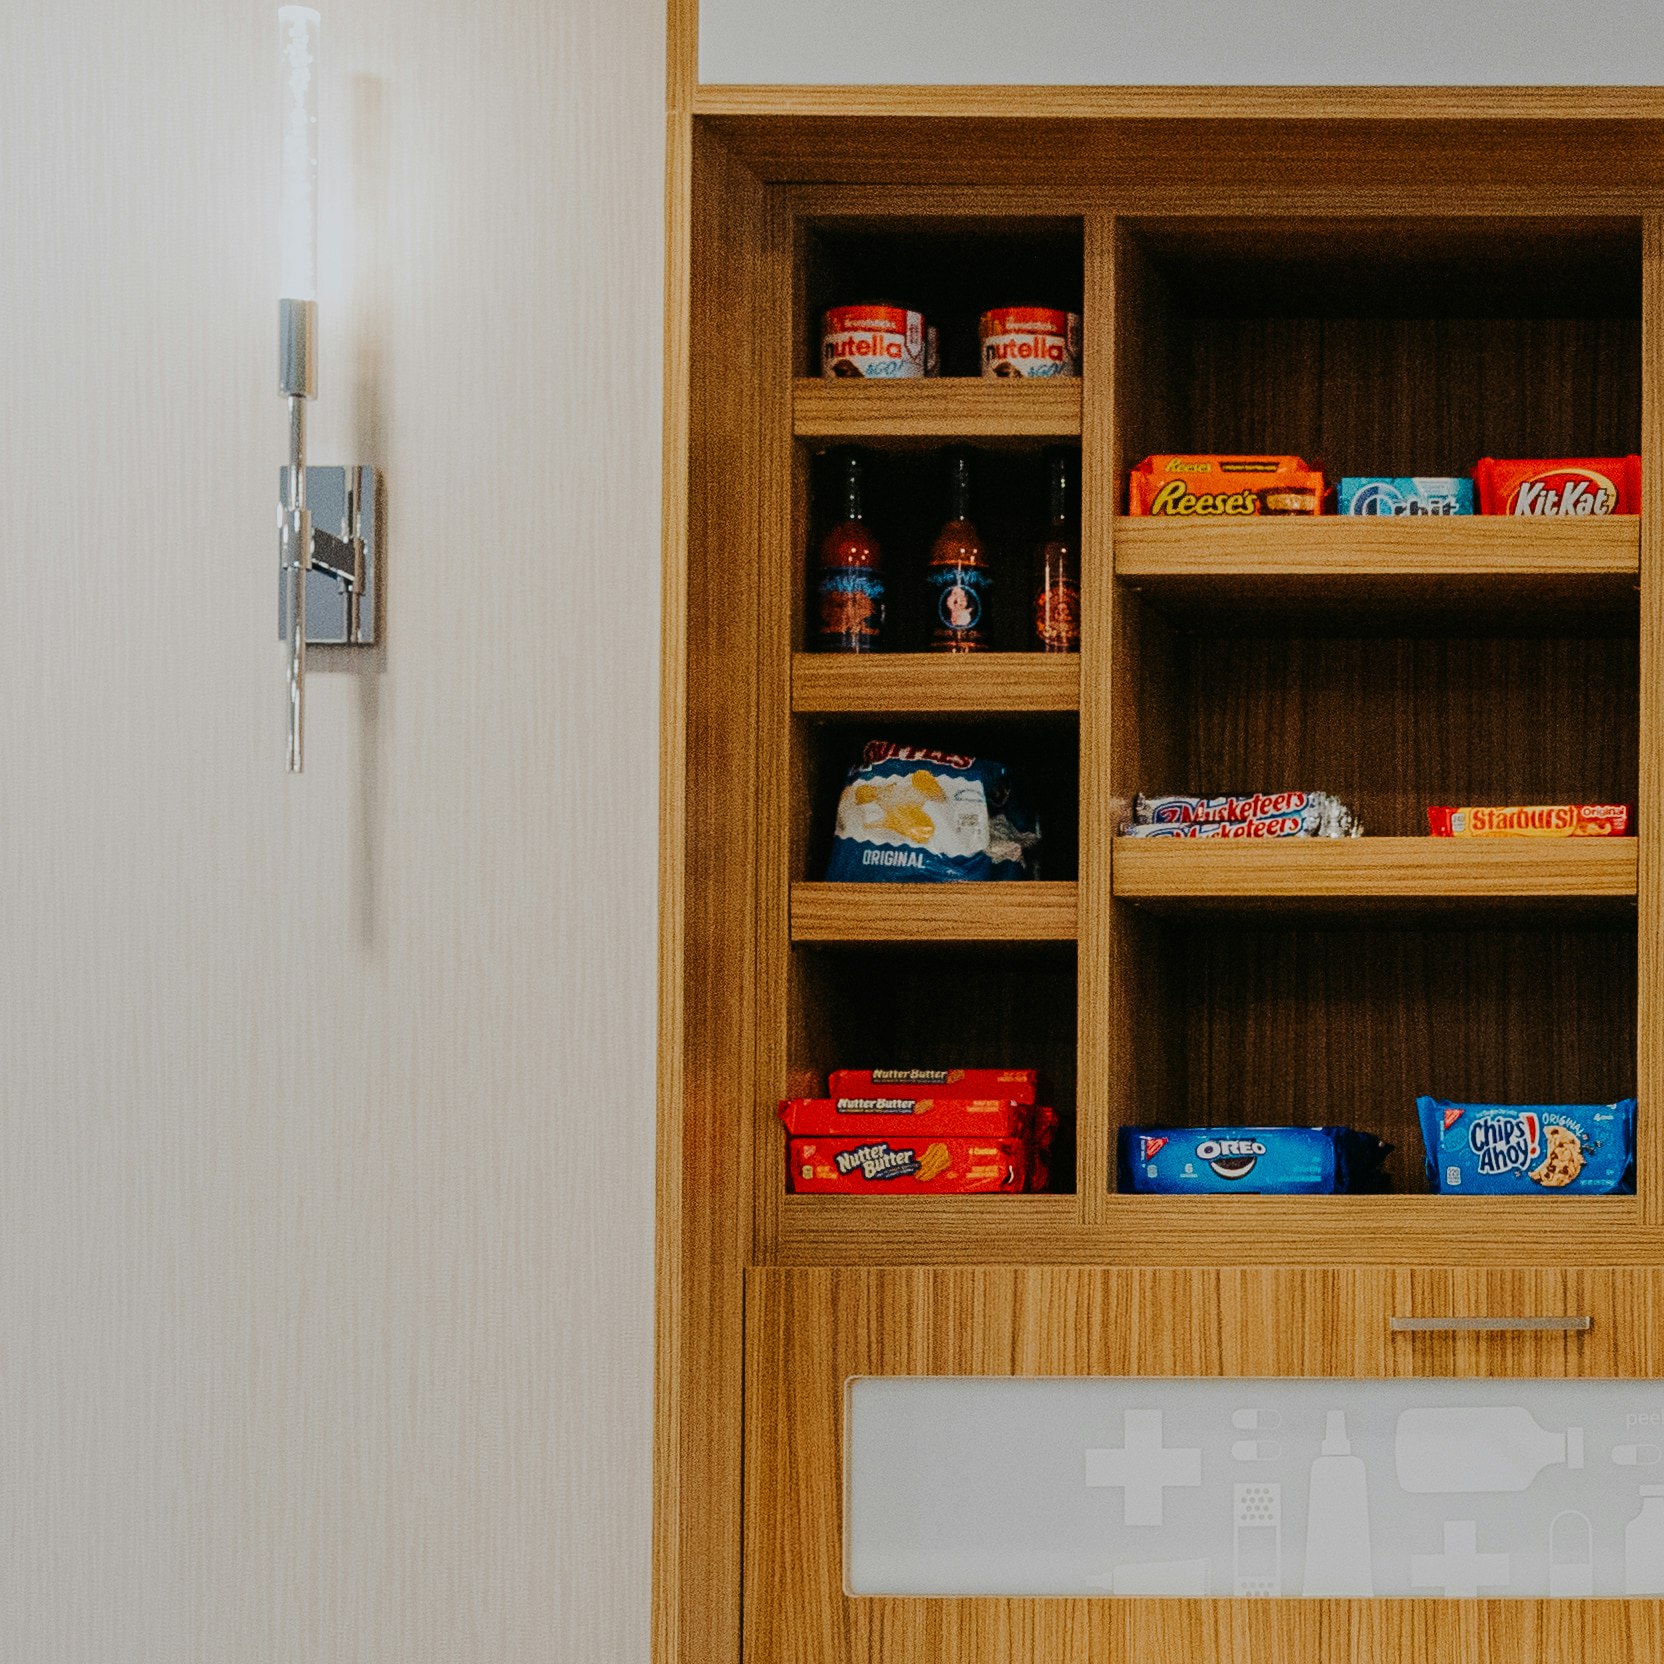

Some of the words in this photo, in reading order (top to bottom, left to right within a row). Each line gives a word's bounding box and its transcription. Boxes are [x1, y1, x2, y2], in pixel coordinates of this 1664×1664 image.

[826, 335, 902, 359] nutella
[986, 336, 1063, 361] nutella
[1152, 480, 1258, 515] Reese's
[1471, 806, 1576, 834] Starburst
[863, 850, 926, 868] ORIGINAL
[837, 1098, 874, 1109] Nutter
[876, 1099, 915, 1109] Butter
[1471, 1117, 1526, 1152] Chips
[836, 1143, 888, 1173] Nutter
[1196, 1139, 1266, 1160] OREO
[863, 1150, 914, 1178] Butter
